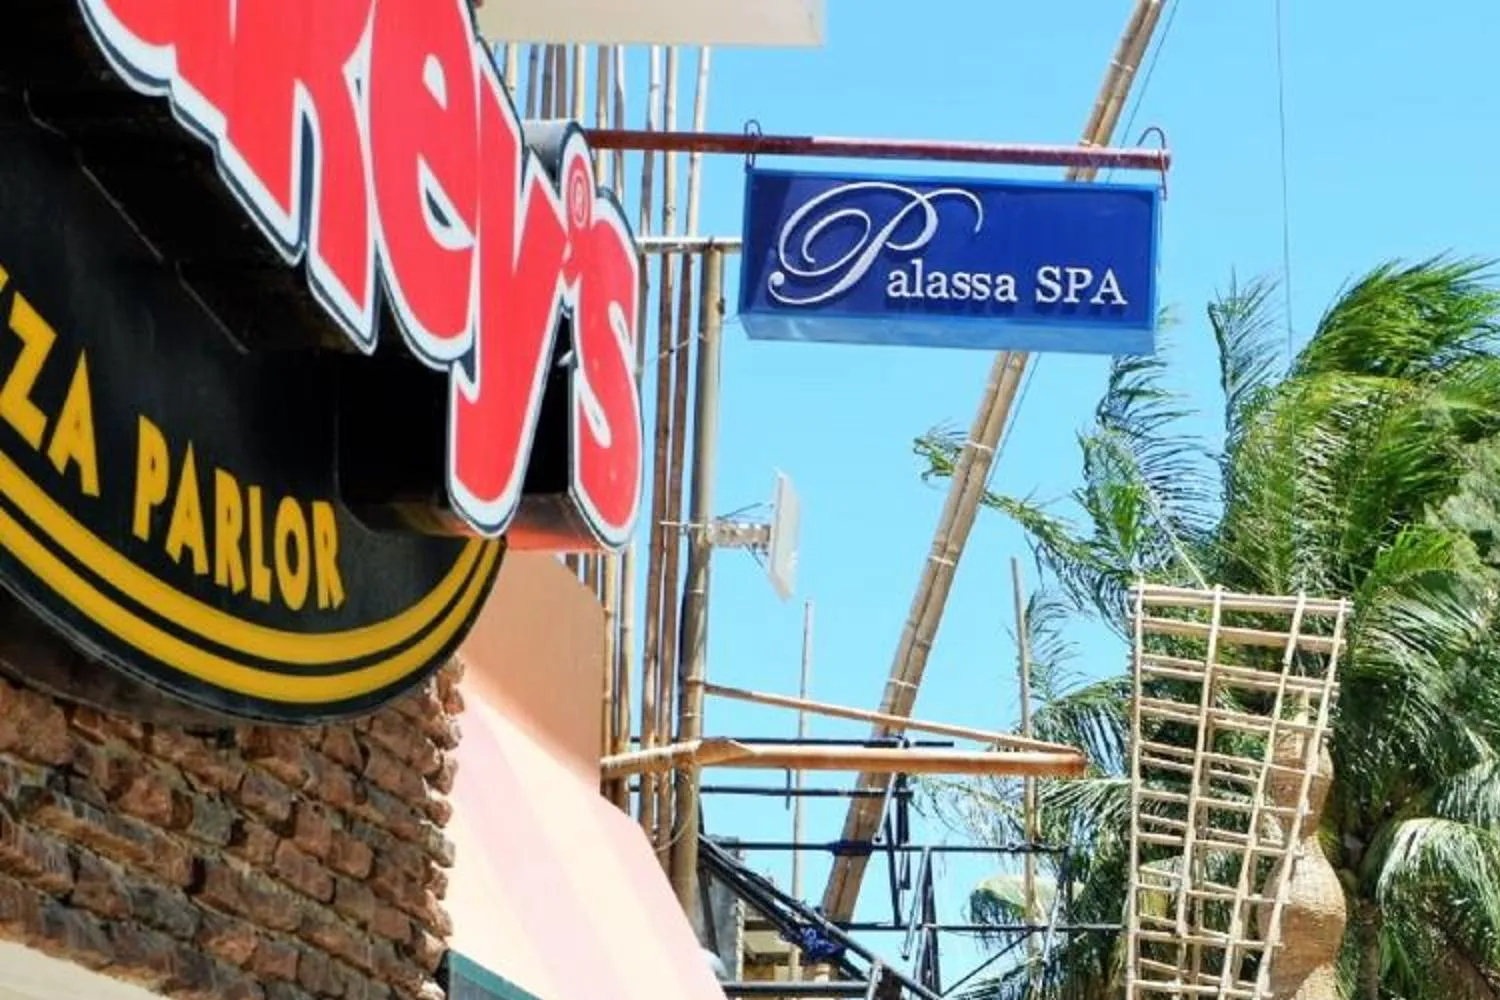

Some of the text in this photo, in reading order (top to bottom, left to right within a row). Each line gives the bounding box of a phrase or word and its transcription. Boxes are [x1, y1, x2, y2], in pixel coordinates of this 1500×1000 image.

[80, 0, 642, 552] key's
[768, 181, 1128, 306] Palassa SPA
[0, 263, 344, 611] ZA PARLOR
